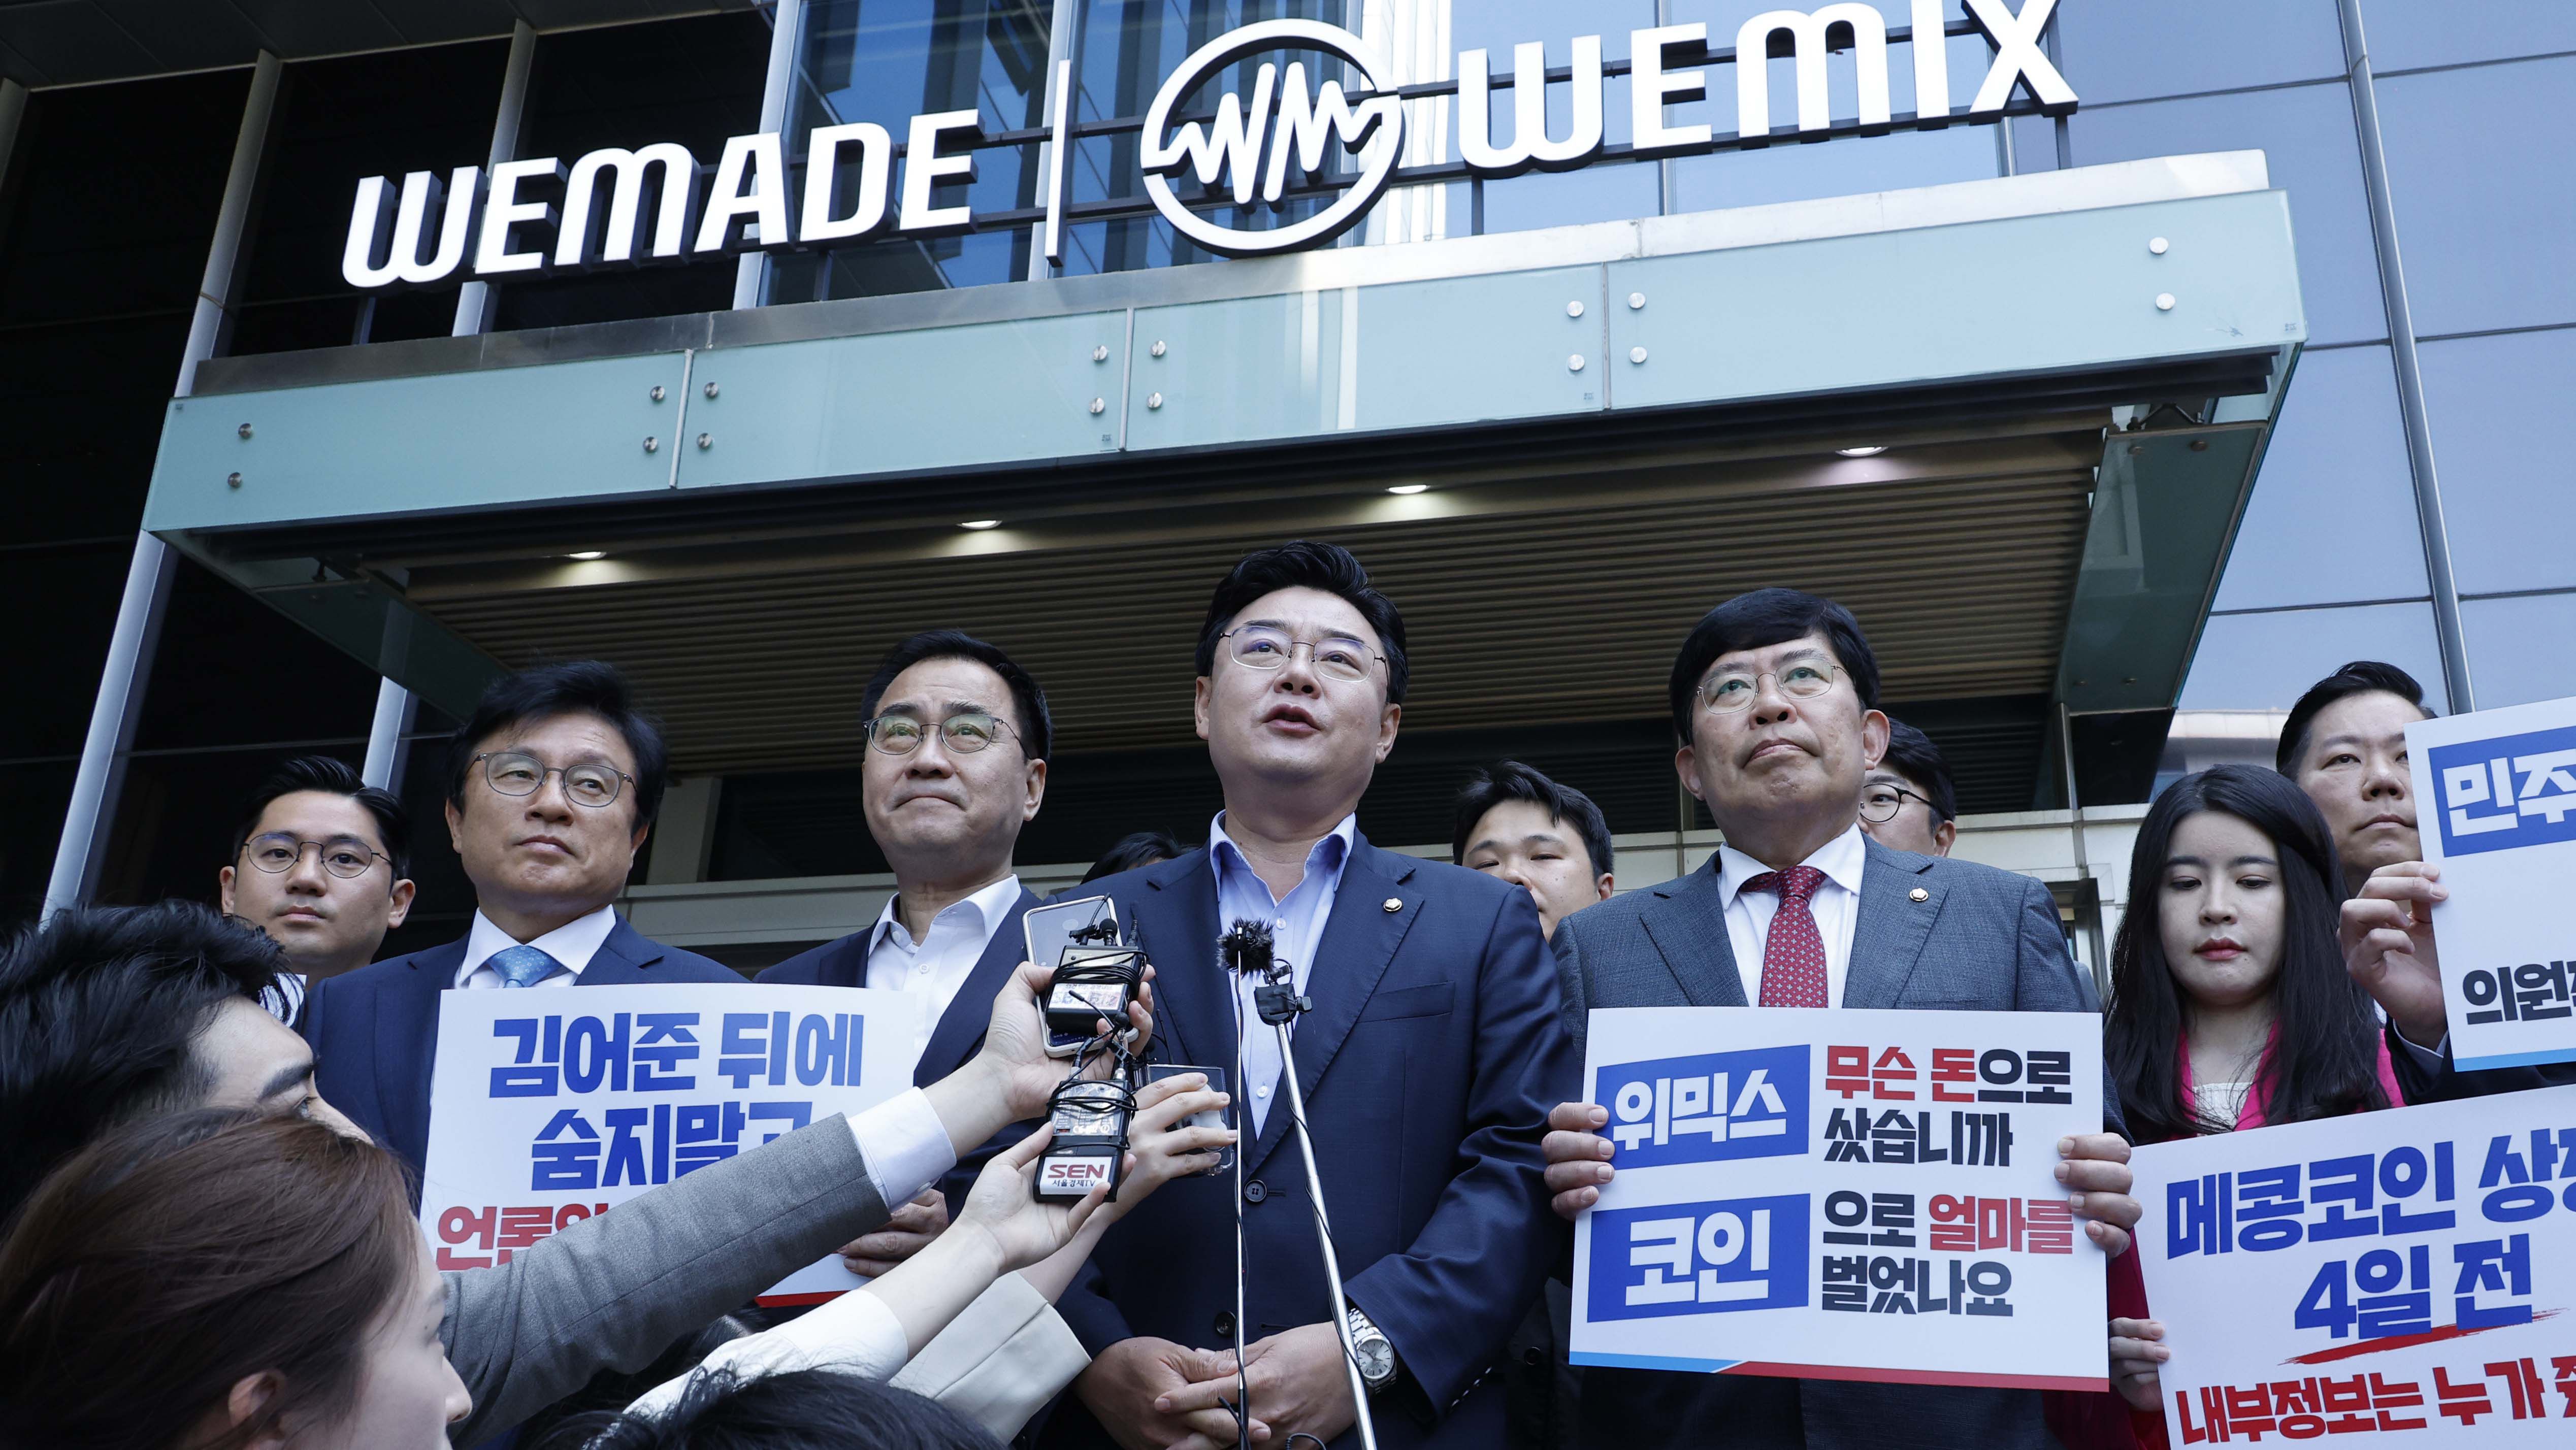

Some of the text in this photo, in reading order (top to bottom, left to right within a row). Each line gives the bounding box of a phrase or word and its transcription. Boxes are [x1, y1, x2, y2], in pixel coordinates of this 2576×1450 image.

[1457, 0, 2079, 173] WEMIX
[341, 109, 982, 289] WEMADE
[2462, 960, 2576, 1025] 의원
[489, 1011, 864, 1099] 김어준 뒤에
[1825, 1045, 2072, 1105] 무슨 돈으로
[1612, 1068, 1787, 1151] 위믹스
[1823, 1107, 2013, 1167] 샀습니까
[1047, 1164, 1105, 1178] SEN
[1052, 1179, 1096, 1188] 서울경제TV
[2166, 1127, 2576, 1260] 메콩코인 상
[1625, 1208, 1771, 1306] 코인
[1822, 1190, 2073, 1254] 으로 얼마를
[1821, 1255, 2013, 1317] 벌었나요
[2294, 1232, 2533, 1340] 4일 전
[2175, 1371, 2428, 1445] 내부정보는
[2432, 1357, 2546, 1426] 누가
